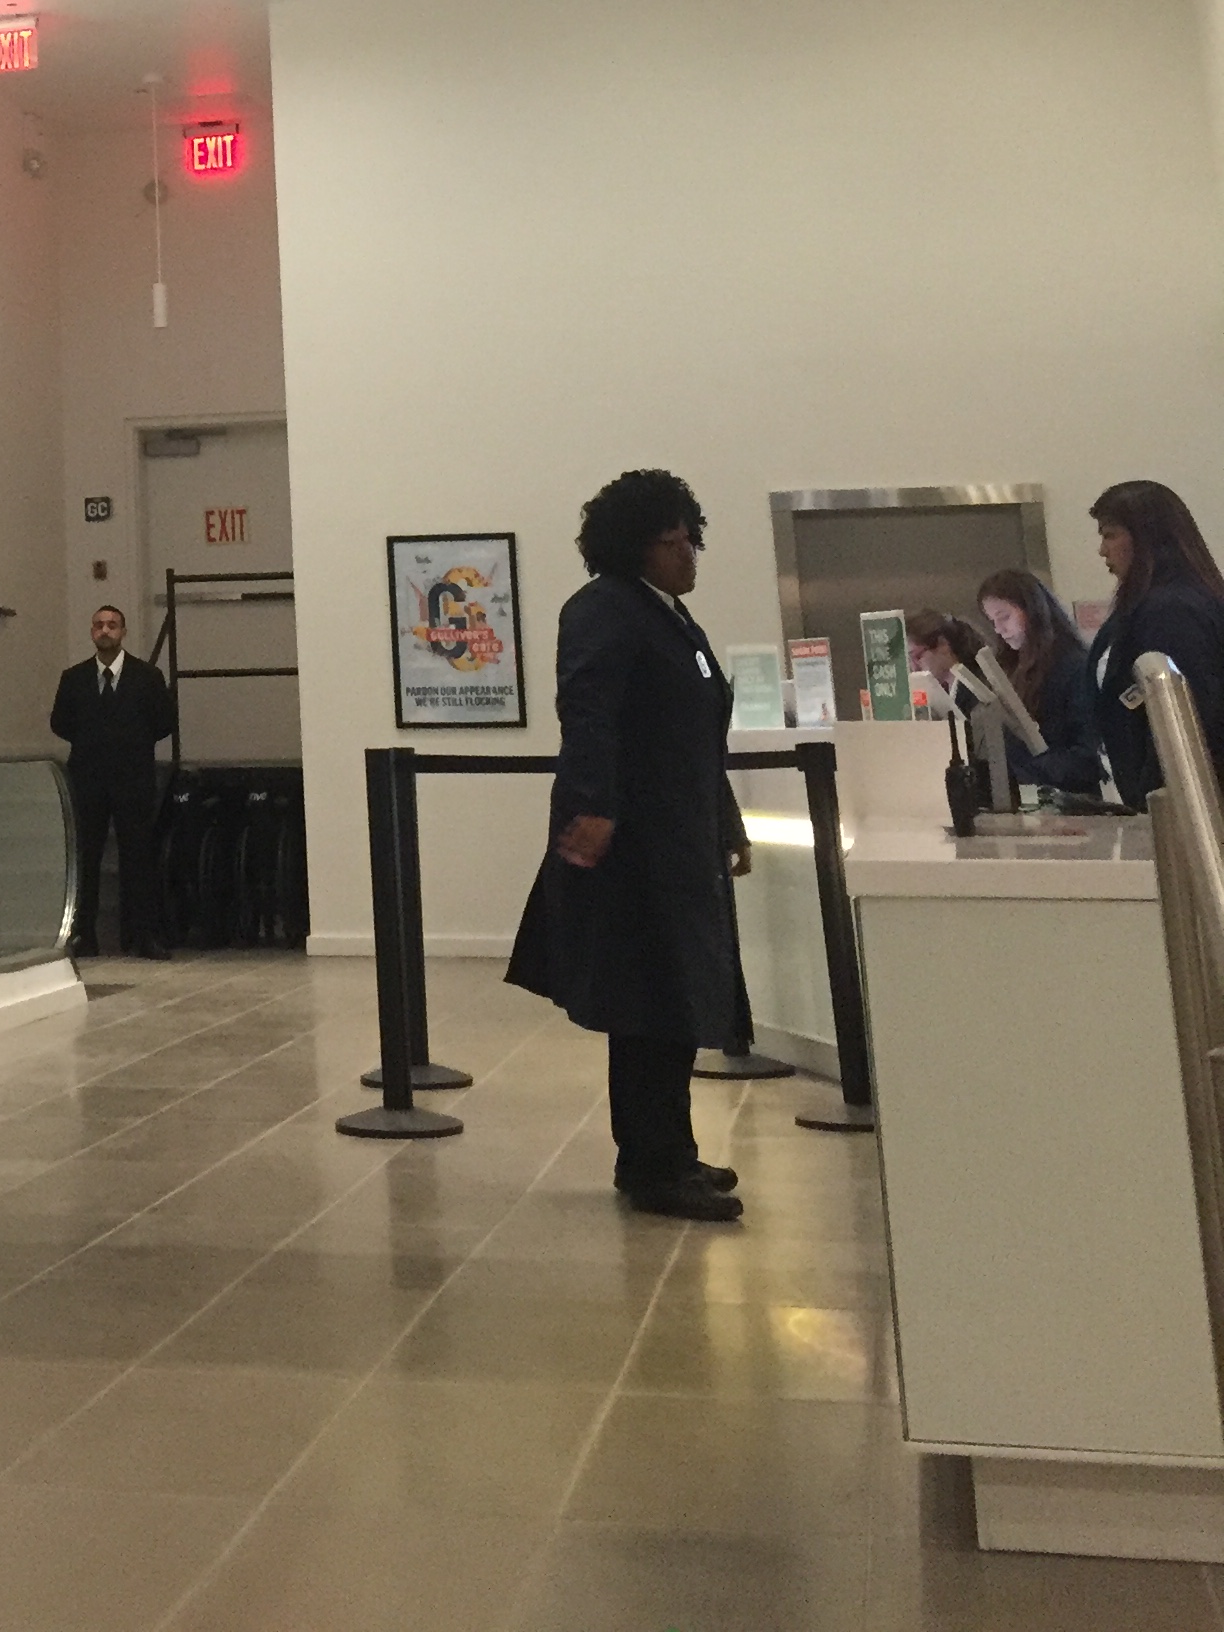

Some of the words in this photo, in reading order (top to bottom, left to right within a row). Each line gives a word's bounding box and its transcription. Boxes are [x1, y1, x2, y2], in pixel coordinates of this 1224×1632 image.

[192, 134, 235, 171] EXIT
[204, 508, 247, 543] EXIT
[405, 686, 439, 696] PARDON
[440, 686, 457, 696] OUR
[458, 685, 514, 696] APPEARANCE
[441, 697, 464, 707] STILL
